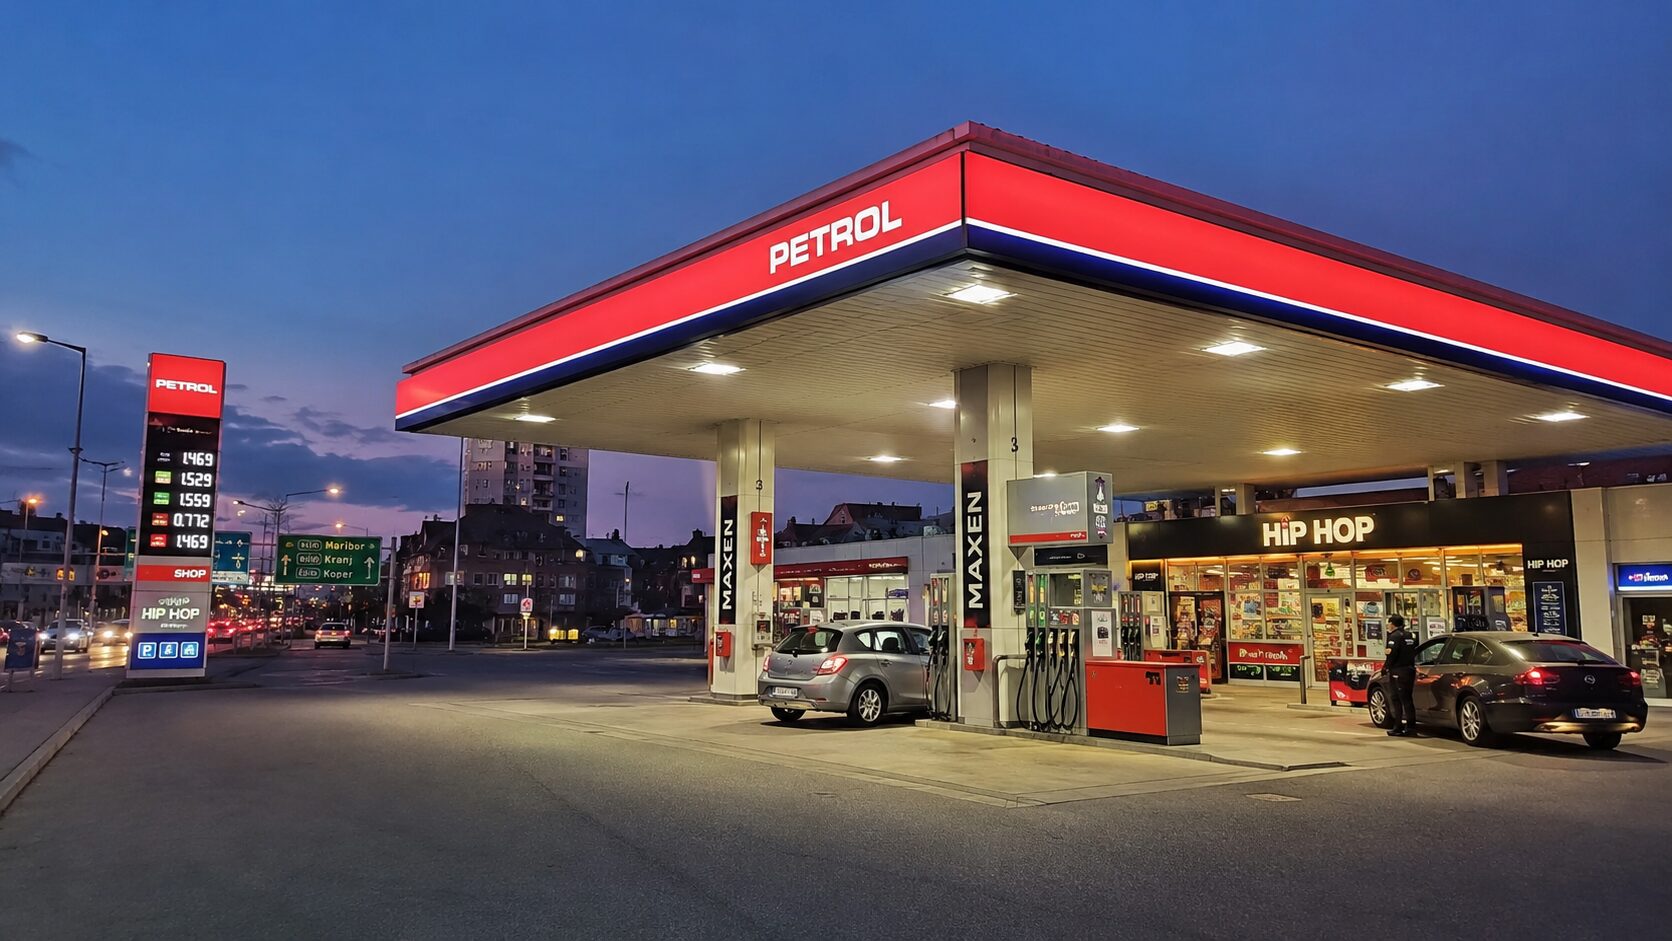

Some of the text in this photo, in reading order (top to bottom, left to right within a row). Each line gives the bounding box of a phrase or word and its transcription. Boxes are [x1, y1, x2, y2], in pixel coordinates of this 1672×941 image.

[769, 200, 903, 275] PETROL
[155, 379, 218, 394] PETROL
[1011, 437, 1019, 452] 3
[182, 451, 214, 467] 1.469
[181, 471, 213, 487] 1.529
[179, 492, 211, 508] 1.559
[173, 512, 210, 528] 0.772
[1313, 515, 1375, 545] HOP
[176, 534, 209, 549] 1.469
[967, 491, 984, 609] MAXEN
[722, 519, 734, 610] MAXEN
[1527, 558, 1569, 569] HIP HOP
[174, 569, 207, 578] SHOP
[323, 569, 353, 579] Koper
[141, 607, 200, 620] HIP HOP
